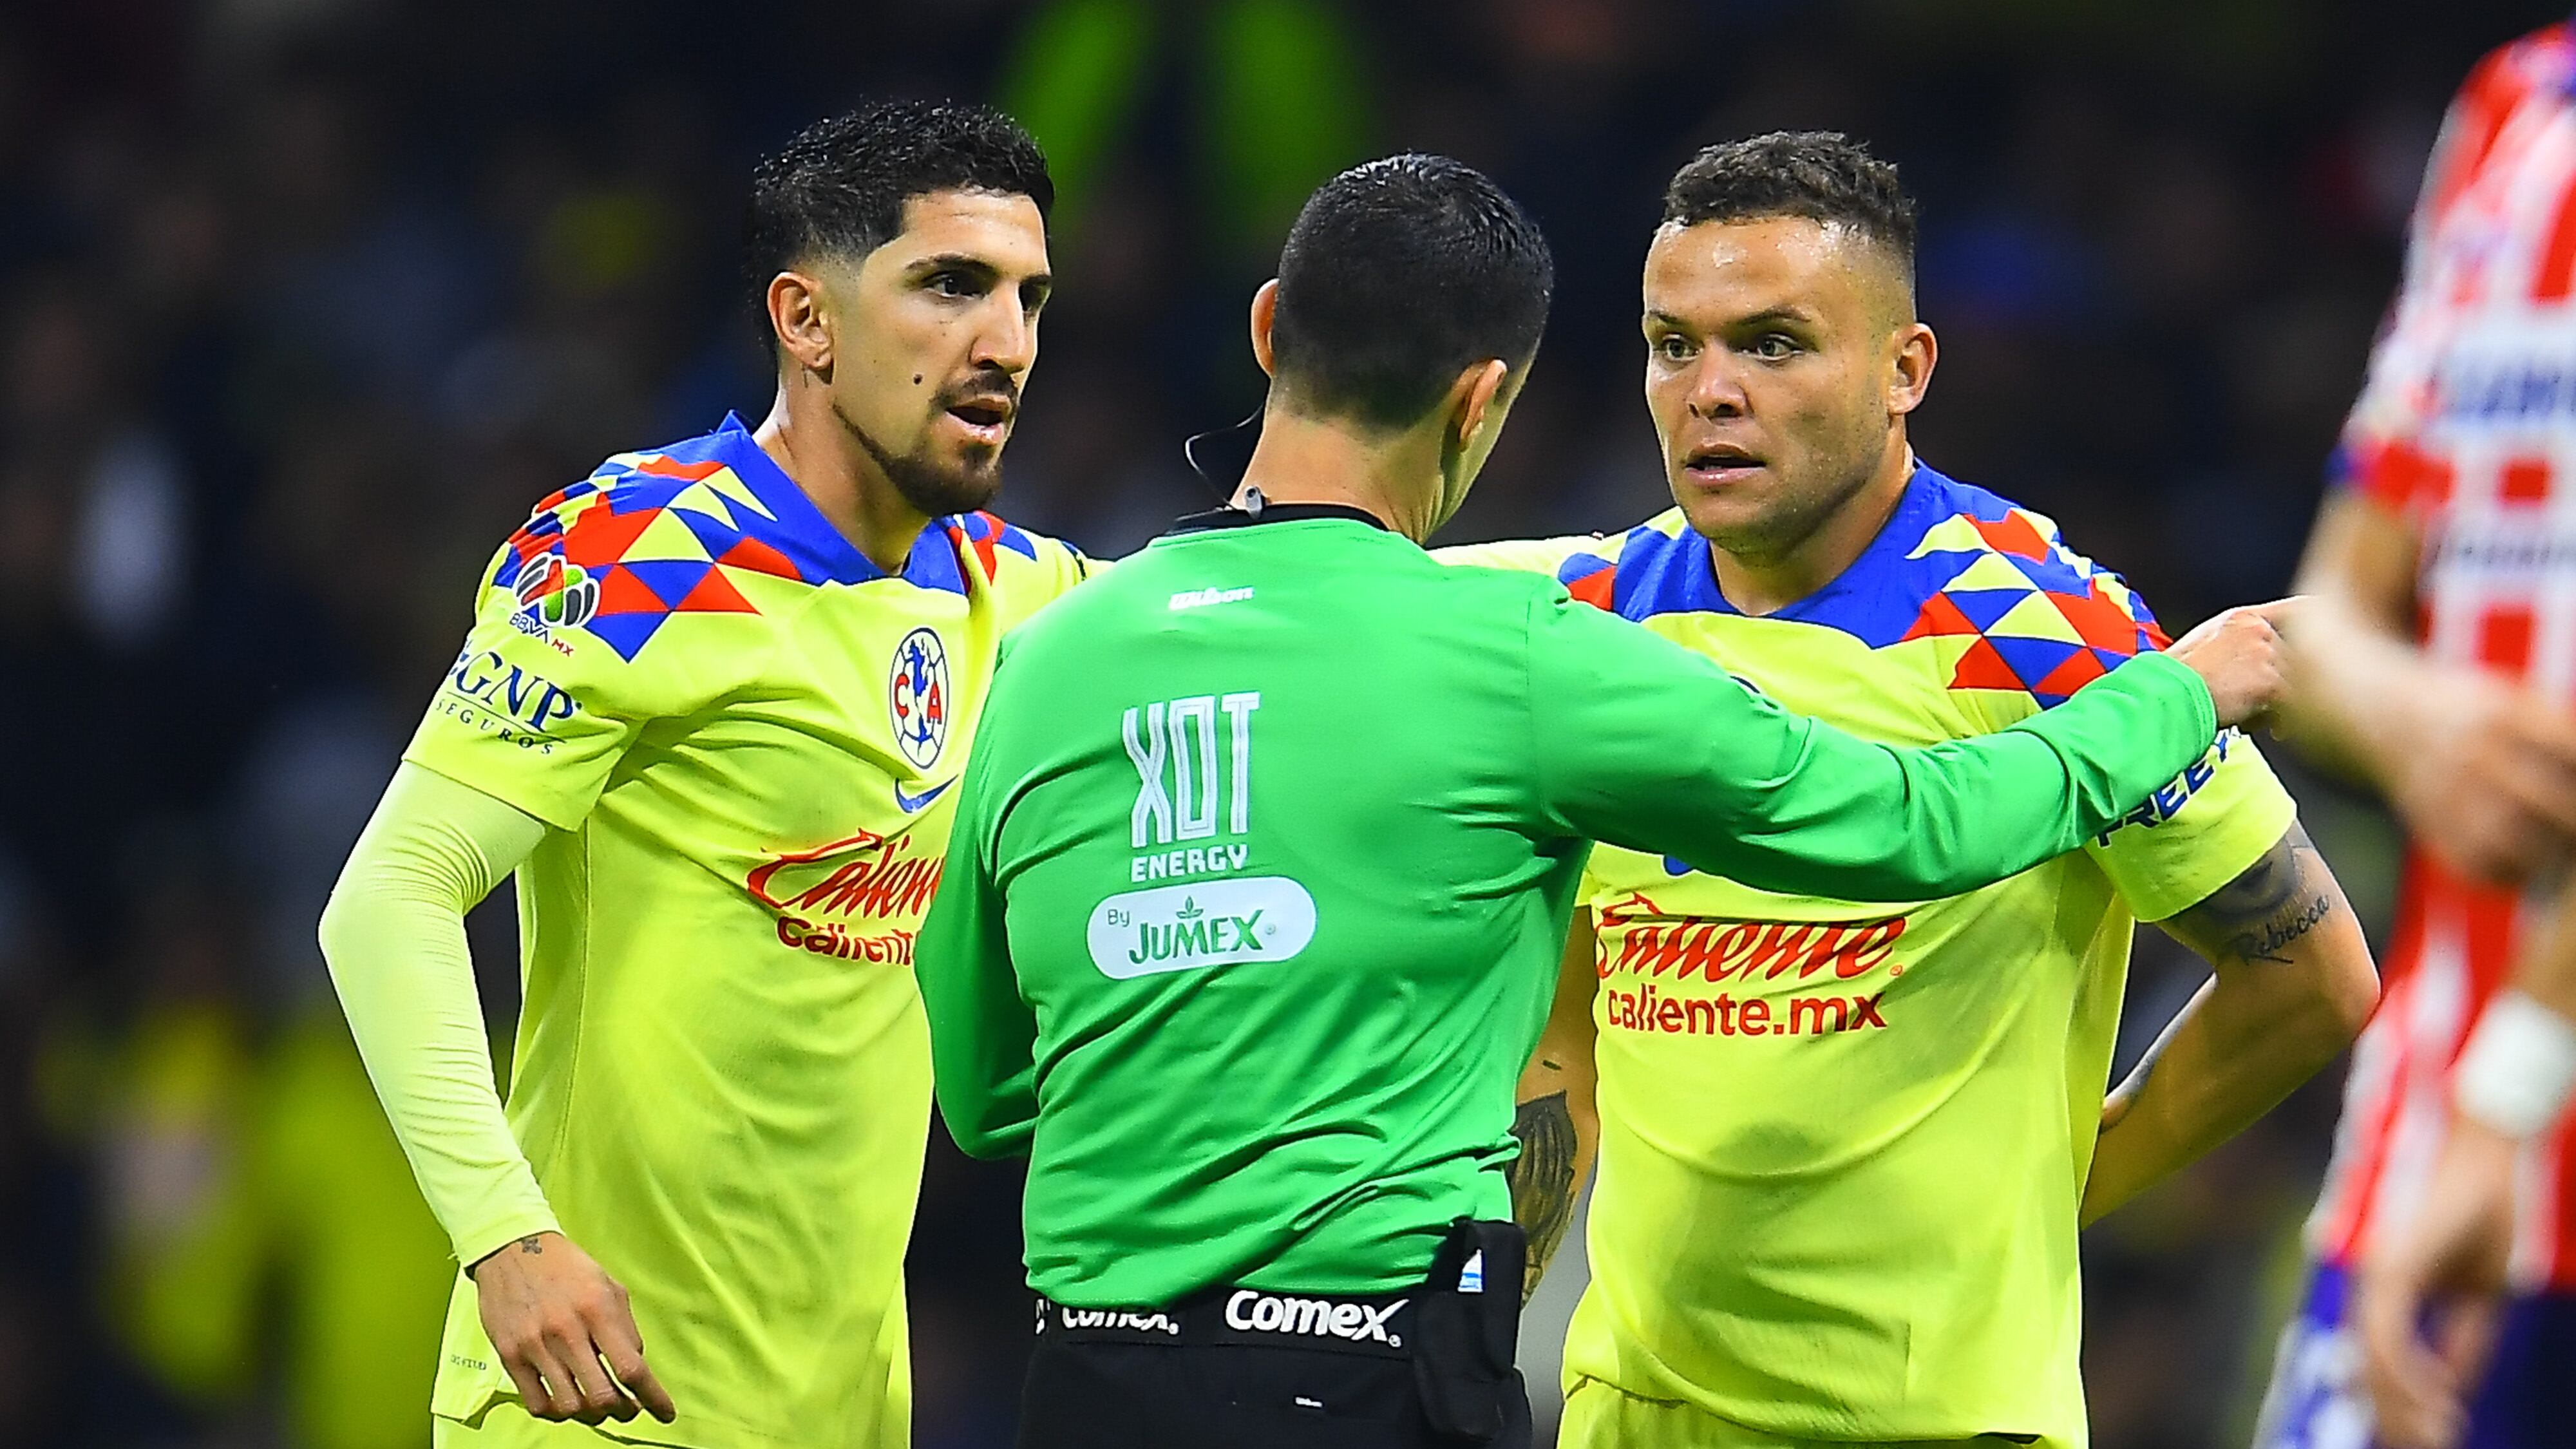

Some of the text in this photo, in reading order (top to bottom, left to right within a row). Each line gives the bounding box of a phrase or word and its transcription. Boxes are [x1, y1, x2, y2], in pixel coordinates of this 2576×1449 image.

[509, 612, 574, 657] BBVA MX
[456, 651, 573, 733] GNP
[436, 699, 553, 754] SEGUROS
[1122, 692, 1260, 848] XOT
[1131, 844, 1248, 882] ENERGY
[1108, 909, 1130, 927] By
[1128, 909, 1265, 965] JUMEX
[1609, 984, 1887, 1035] caliente.mx
[1225, 1290, 1409, 1341] Comex
